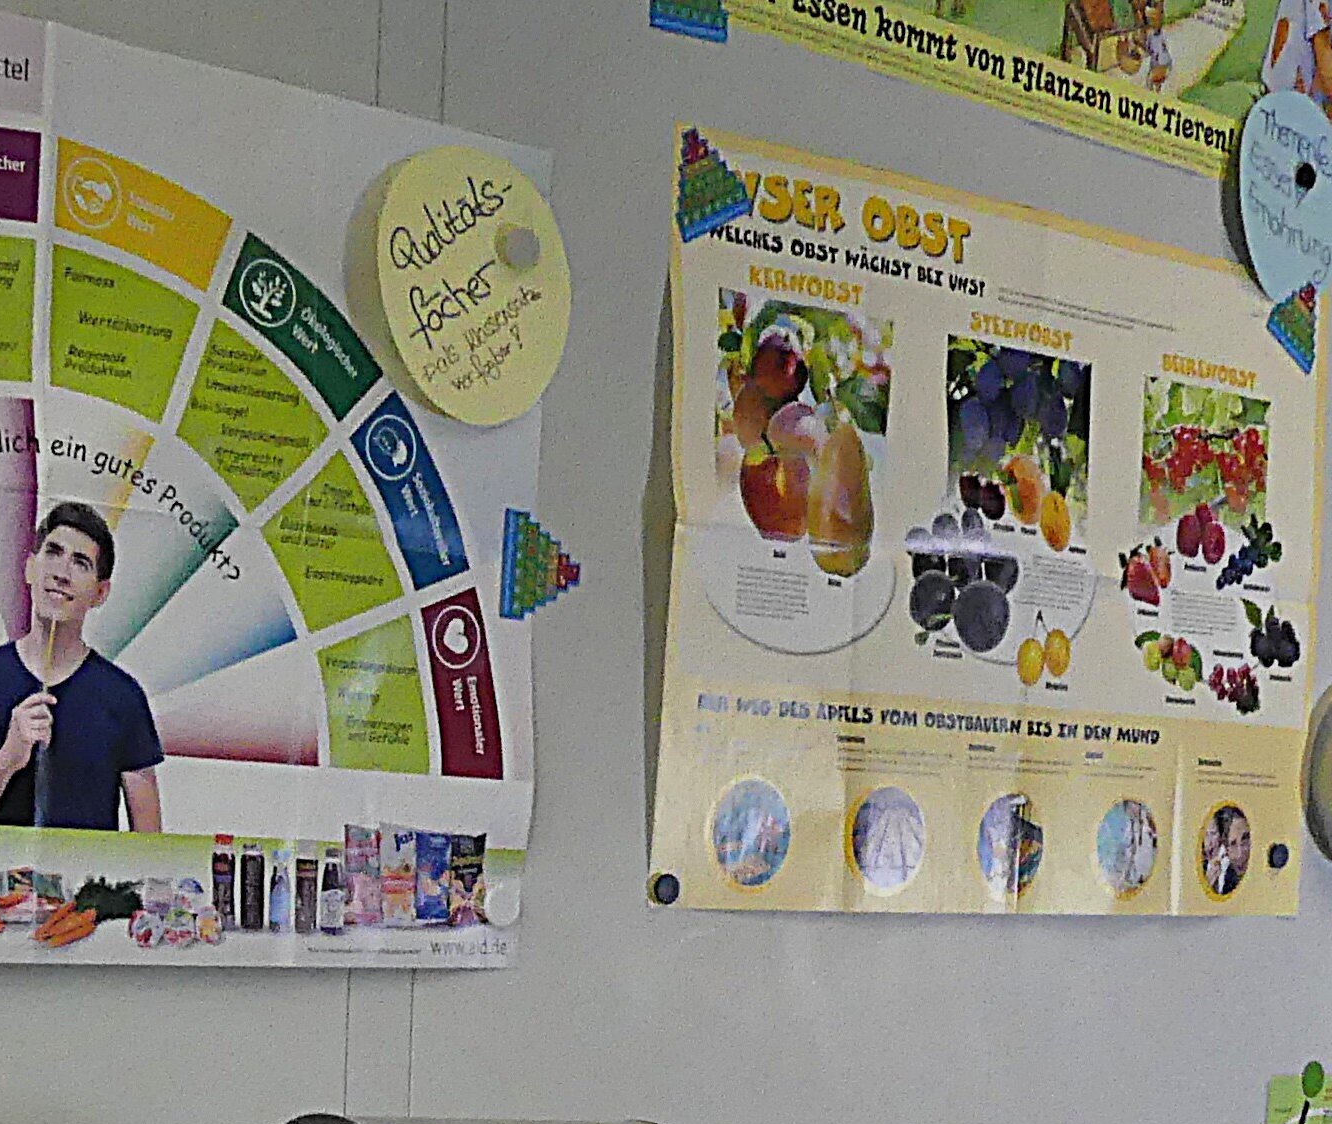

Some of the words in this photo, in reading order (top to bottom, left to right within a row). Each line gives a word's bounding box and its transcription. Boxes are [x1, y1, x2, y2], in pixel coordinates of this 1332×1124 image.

[874, 5, 957, 62] kommt
[964, 43, 1005, 81] von
[1011, 55, 1112, 115] Pflanzen
[1117, 95, 1158, 128] und
[1162, 108, 1235, 154] Tieren!
[744, 170, 846, 234] SER
[862, 194, 971, 266] OBST
[708, 225, 783, 254] WELCHES
[791, 238, 839, 265] OBST
[845, 245, 913, 280] WÄCHST
[918, 265, 943, 287] BEI
[748, 264, 863, 305] KERNOBST
[969, 310, 1075, 351] STEINOBST
[50, 439, 88, 463] ein
[92, 452, 158, 496] gutes
[158, 484, 241, 582] Produkt?
[817, 701, 874, 725] APFELS
[880, 708, 917, 728] VOM
[1027, 719, 1052, 738] BIS
[1057, 722, 1078, 739] IN
[1084, 724, 1111, 741] DEN
[1116, 727, 1160, 746] MUND
